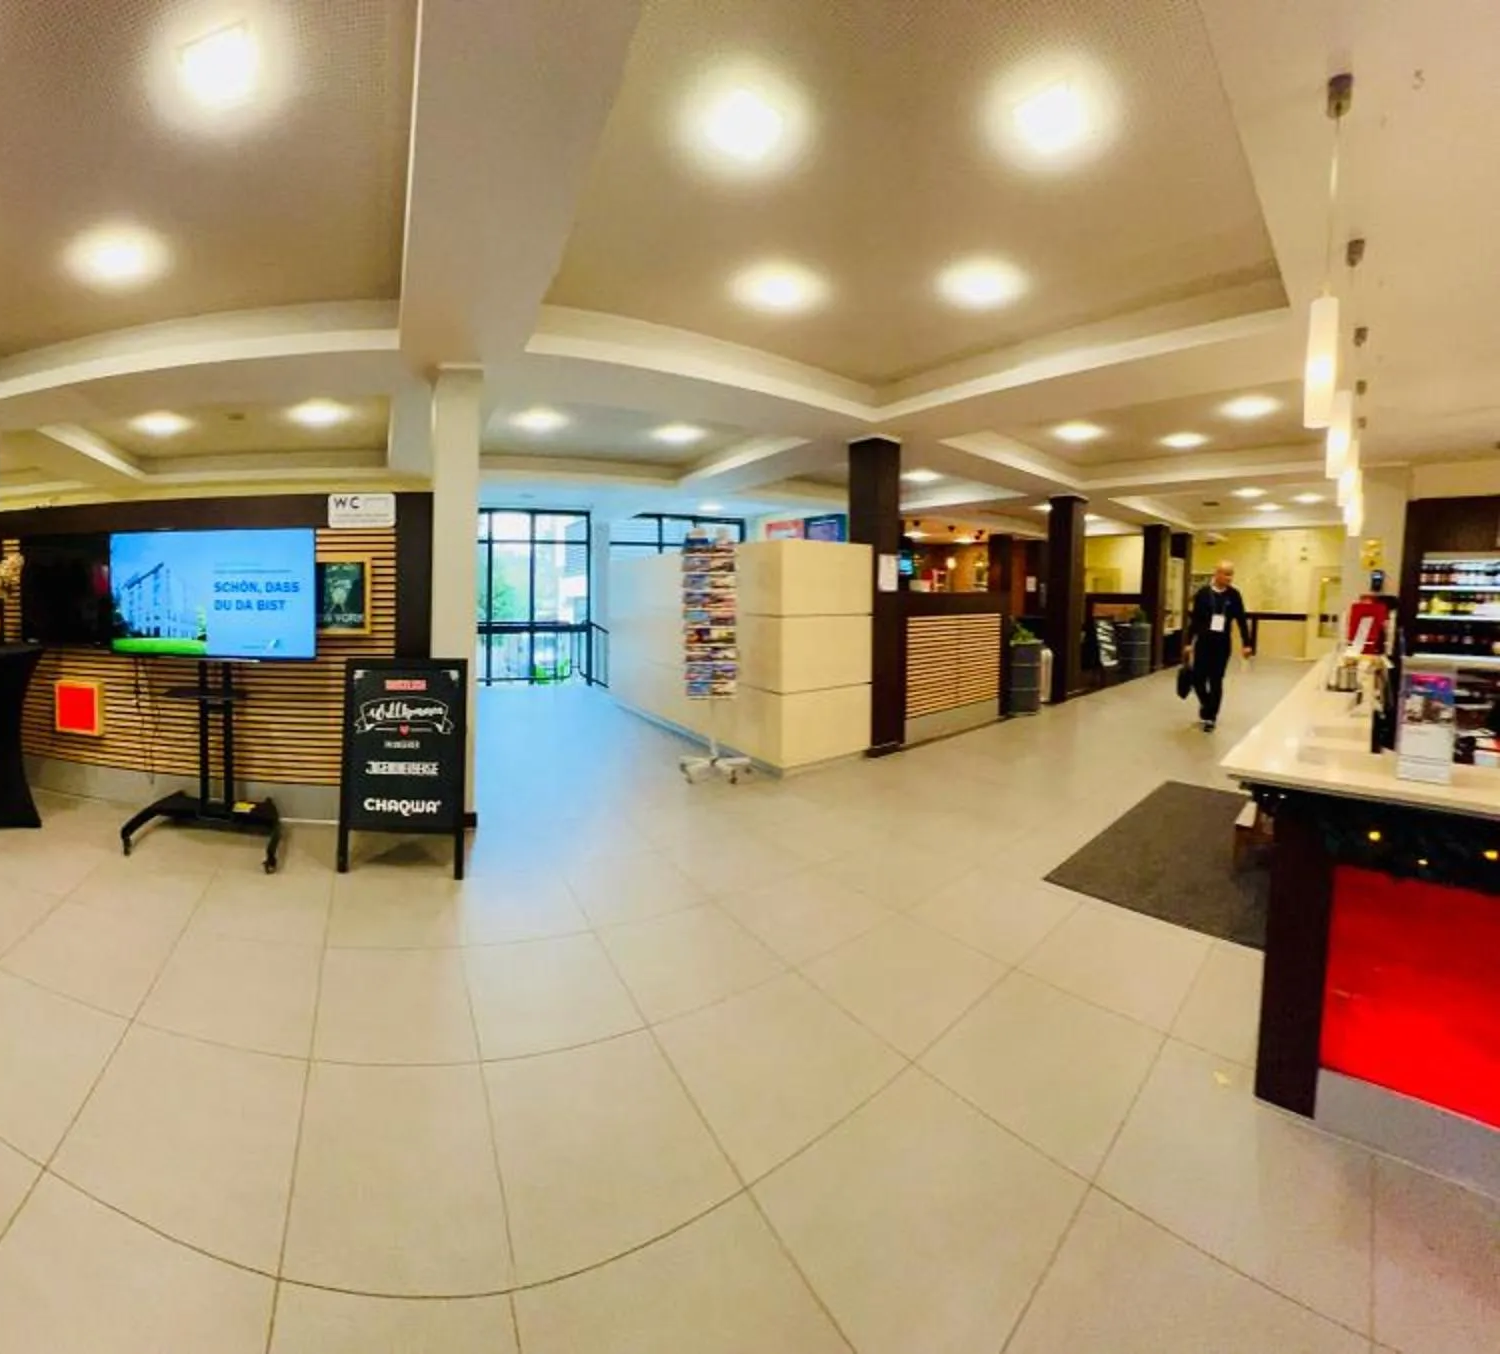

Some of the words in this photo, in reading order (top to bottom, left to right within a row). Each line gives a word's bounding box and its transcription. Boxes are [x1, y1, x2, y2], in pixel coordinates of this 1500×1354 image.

[265, 581, 301, 593] DASS
[214, 599, 232, 611] DU
[235, 599, 253, 611] DA
[257, 599, 286, 611] BIST
[363, 798, 438, 817] CHAQWA
